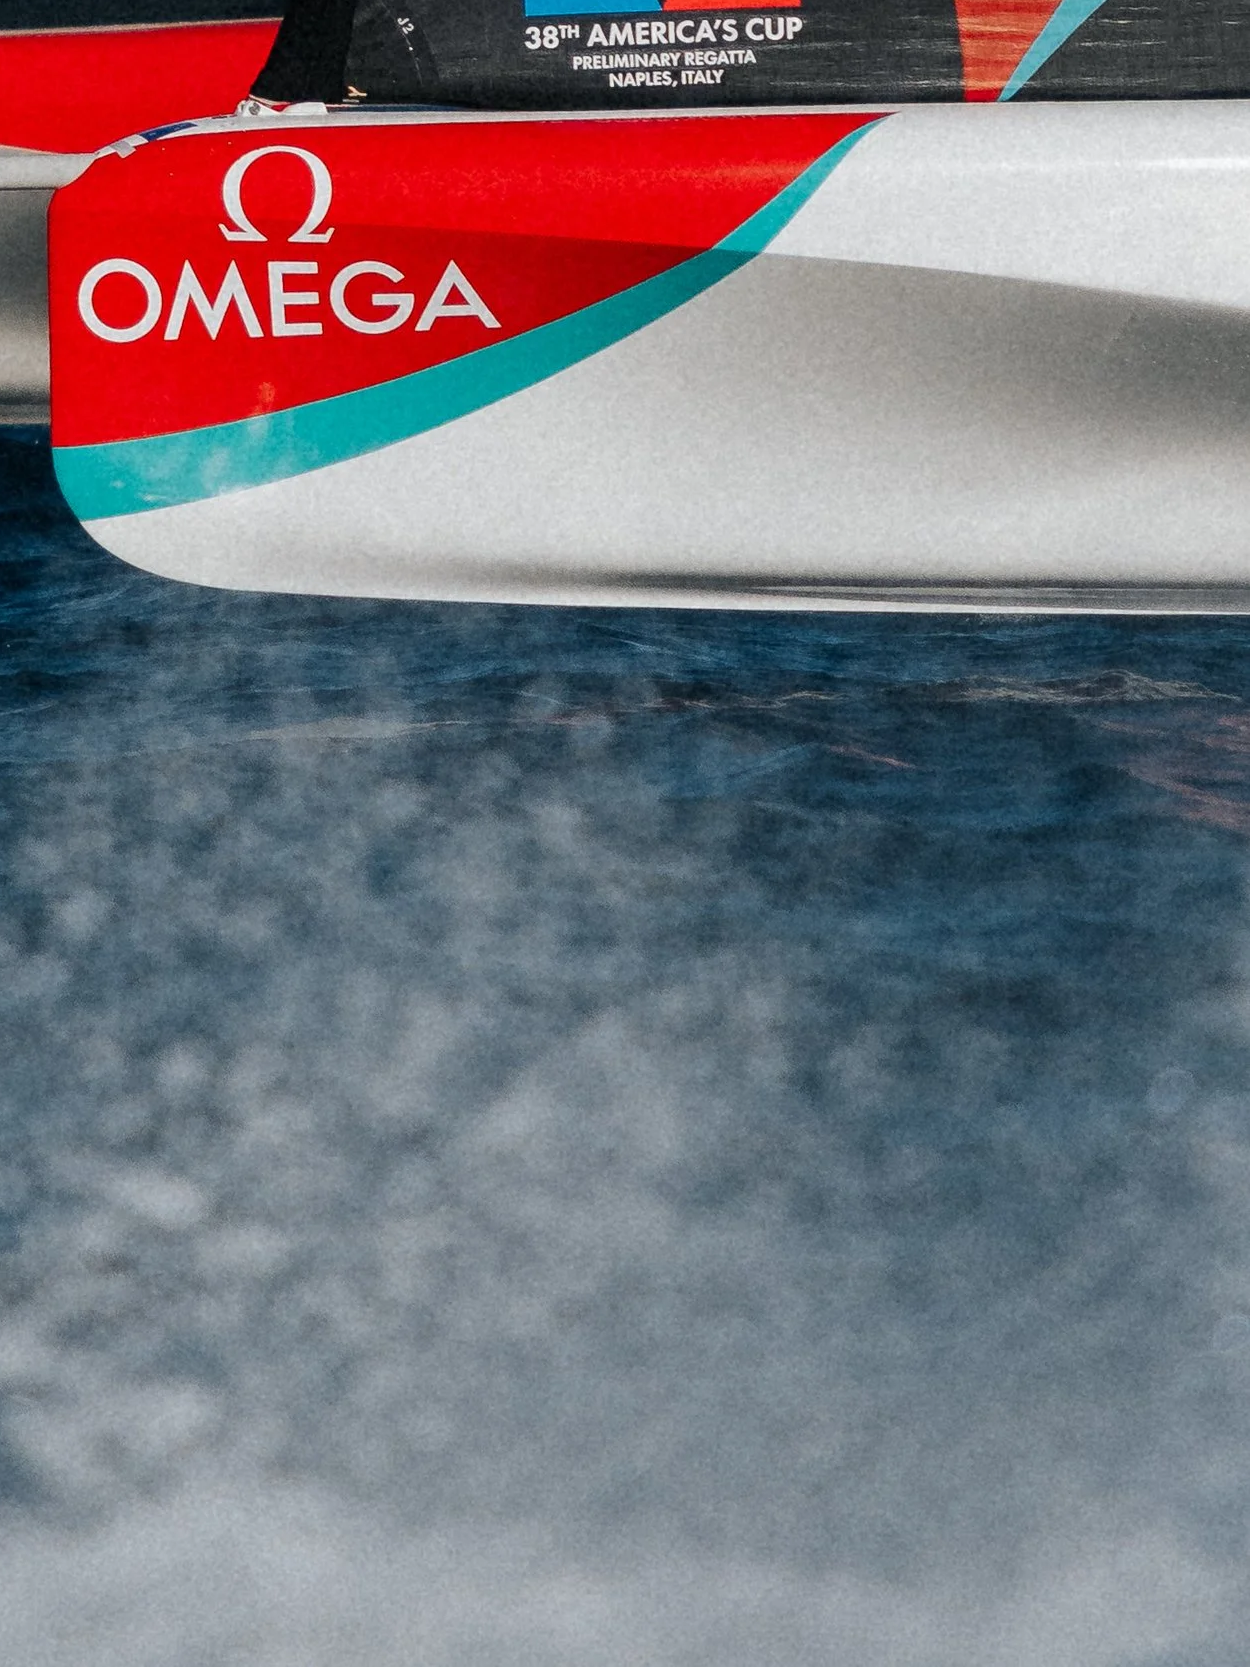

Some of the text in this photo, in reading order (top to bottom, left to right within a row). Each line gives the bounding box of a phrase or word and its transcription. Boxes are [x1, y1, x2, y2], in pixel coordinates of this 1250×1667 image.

[586, 19, 739, 48] AMERICA'S
[745, 15, 804, 42] CUP
[572, 49, 757, 71] PRELIMINARY REGATTA
[609, 69, 724, 88] NAPLES, ITALY
[77, 257, 502, 343] OMEGA
